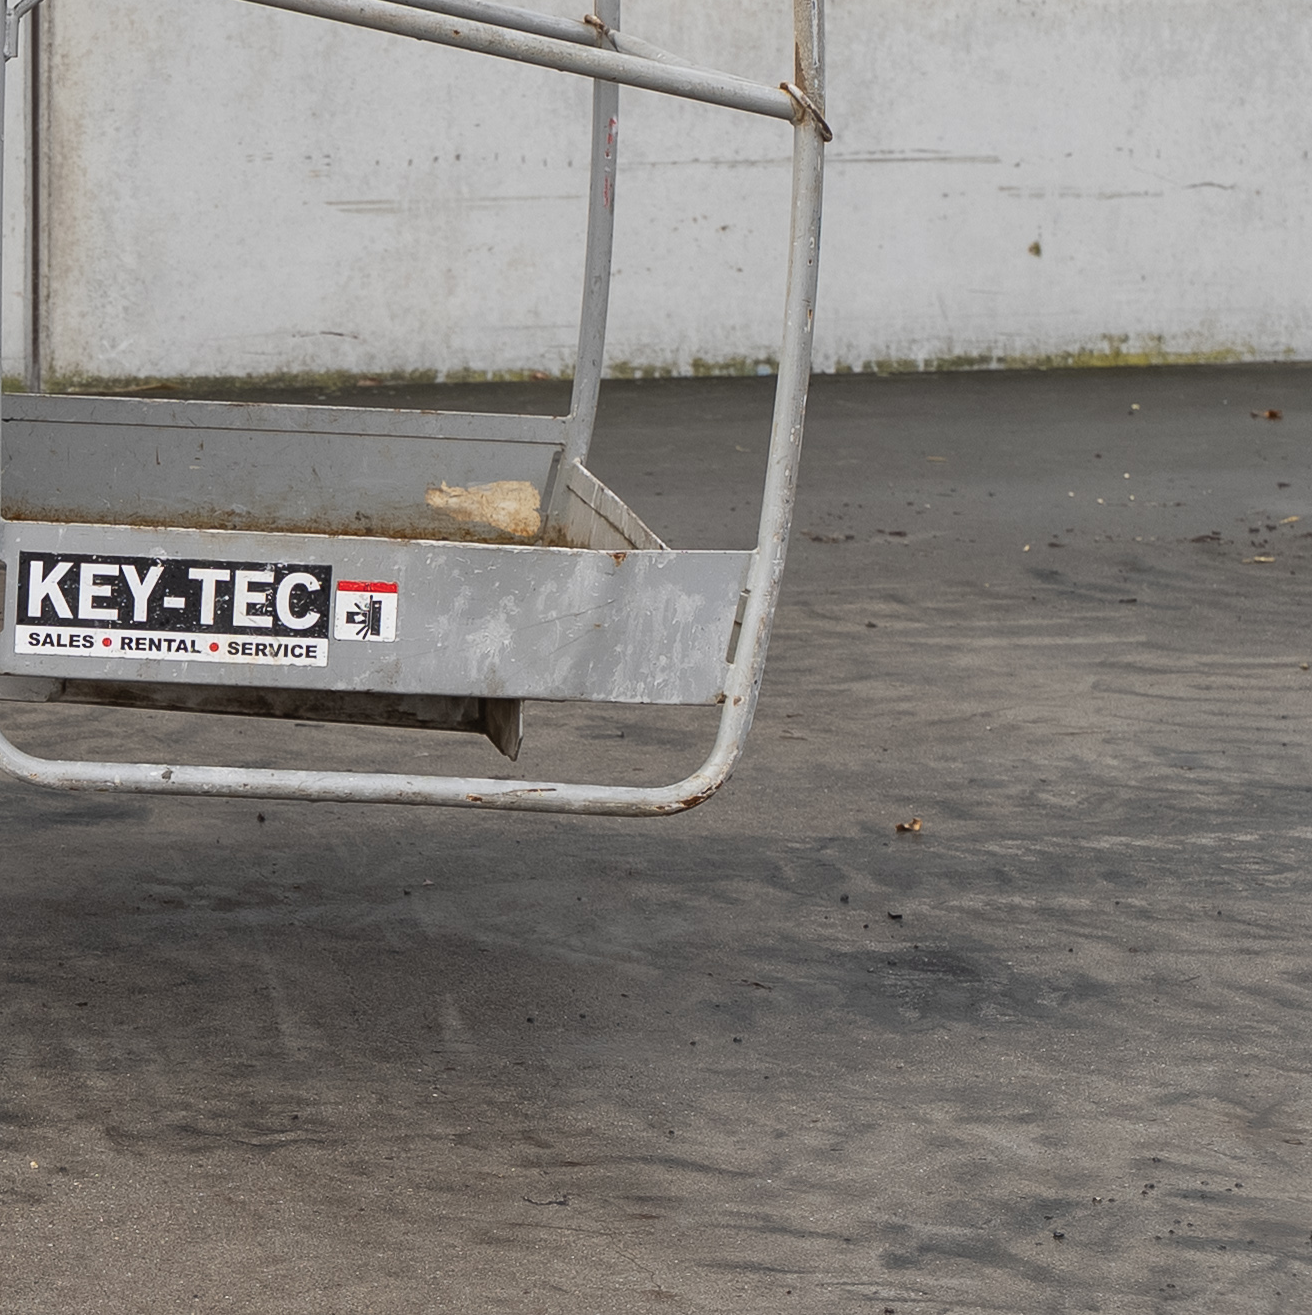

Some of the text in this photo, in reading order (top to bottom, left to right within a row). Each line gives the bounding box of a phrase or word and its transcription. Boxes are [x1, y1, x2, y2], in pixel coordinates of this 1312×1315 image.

[26, 560, 322, 630] KEY-TEC
[28, 632, 318, 659] SALES RENTAL SERVICE
